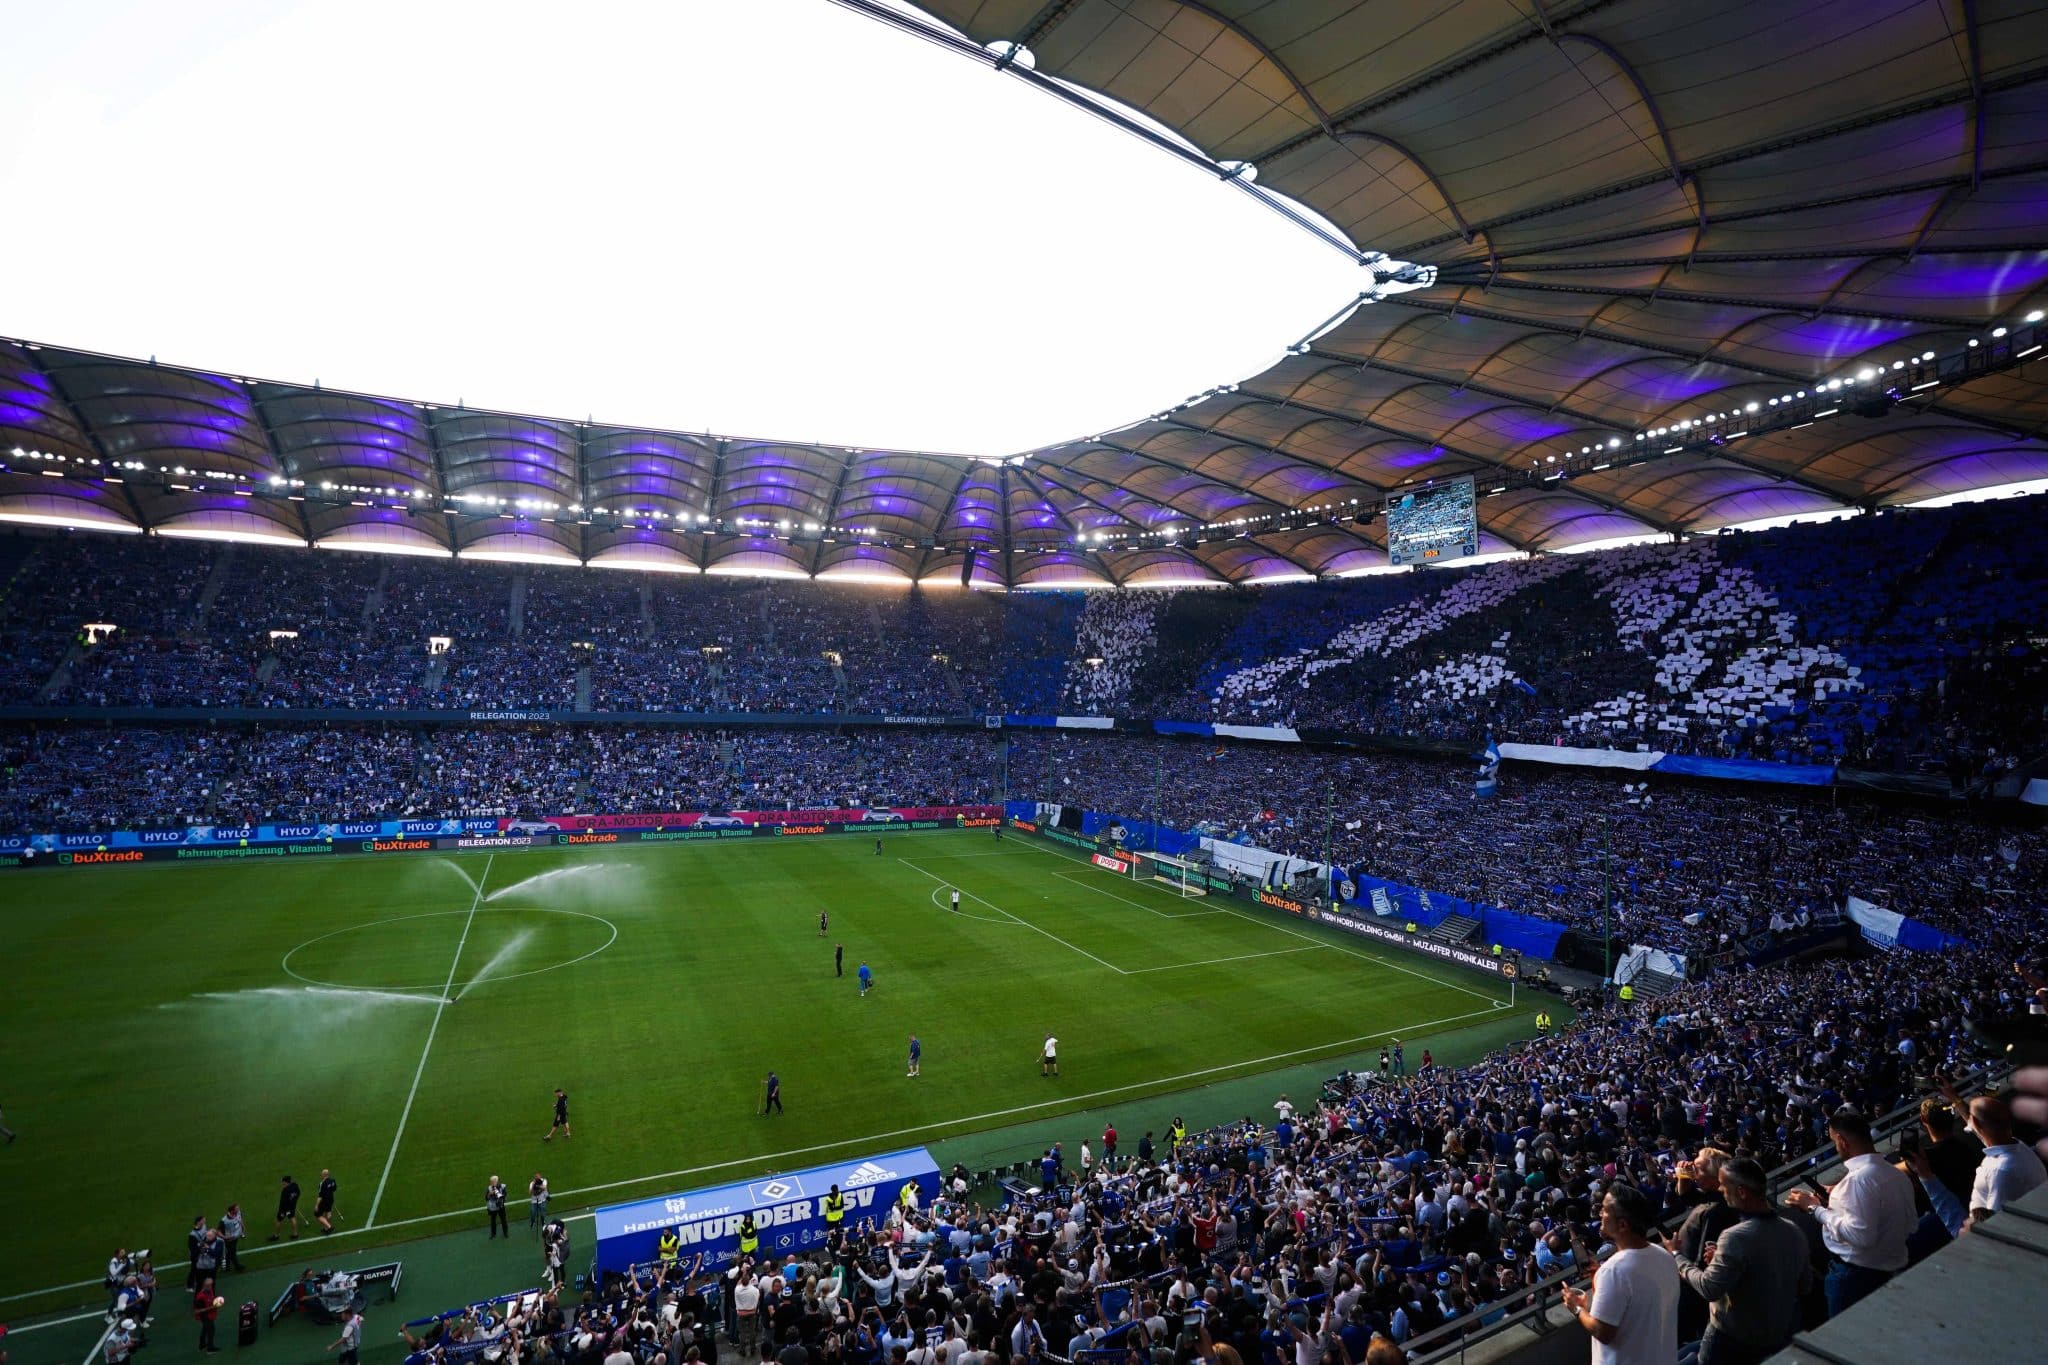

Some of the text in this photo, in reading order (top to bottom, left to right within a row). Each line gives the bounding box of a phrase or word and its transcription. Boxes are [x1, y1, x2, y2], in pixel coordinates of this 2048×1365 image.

[470, 712, 550, 720] RELEGATION 2023
[884, 716, 927, 724] RELEGATION
[407, 822, 435, 832] HYLO
[466, 820, 493, 830] HYLO
[964, 817, 1001, 827] buXtrade
[218, 829, 250, 839] HYLO
[280, 826, 312, 837] HYLO
[345, 824, 375, 834] HYLO
[721, 828, 752, 837] Vitamine
[783, 825, 825, 835] buXtrade
[66, 835, 103, 845] HYLO
[145, 831, 179, 842] HYLO
[458, 837, 531, 846] RELEGATION 2023
[569, 833, 618, 844] buXtrade
[289, 844, 332, 853] Vitamine
[374, 839, 430, 851] buXtrade
[73, 851, 144, 863] buXtrade
[1101, 858, 1117, 868] popp
[1260, 891, 1302, 914] buXtrade
[1321, 911, 1337, 923] VIDIN
[1337, 916, 1354, 930] NORD
[1355, 920, 1383, 937] HOLDING
[1384, 929, 1404, 943] GMBH
[1413, 939, 1451, 957] MUZAFFER
[1452, 951, 1498, 971] VIDINKALESI
[845, 1171, 898, 1187] adidas
[624, 1204, 731, 1233] HanseMerkur
[679, 1214, 744, 1247] NUR
[751, 1200, 812, 1230] DER
